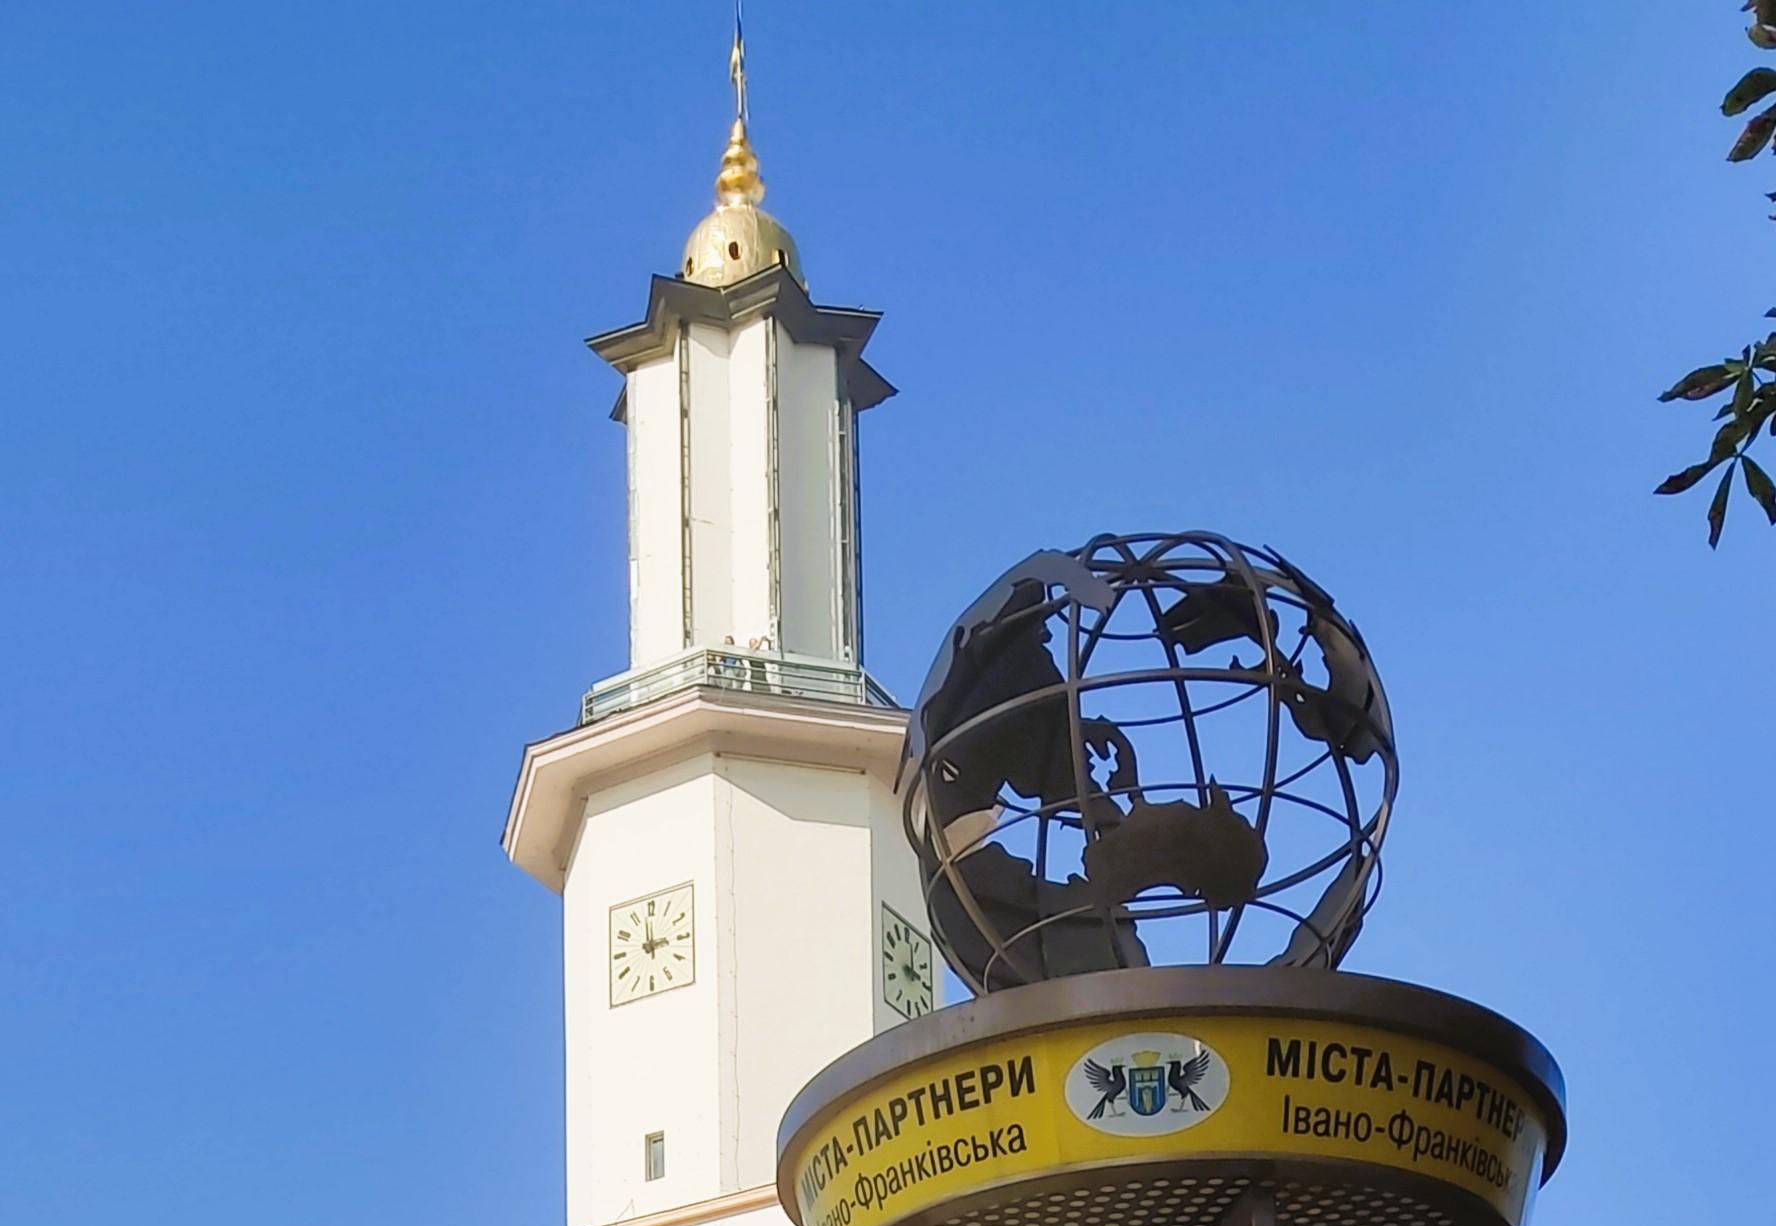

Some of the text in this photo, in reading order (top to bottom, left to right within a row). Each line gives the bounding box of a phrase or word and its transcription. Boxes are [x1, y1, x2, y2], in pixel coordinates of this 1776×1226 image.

[801, 1056, 1036, 1210] МІСТА-ПАРТНЕРИ
[1267, 1038, 1528, 1145] МІСТА-ПАРТНЕР
[1283, 1095, 1515, 1191] Івано-Франківськ
